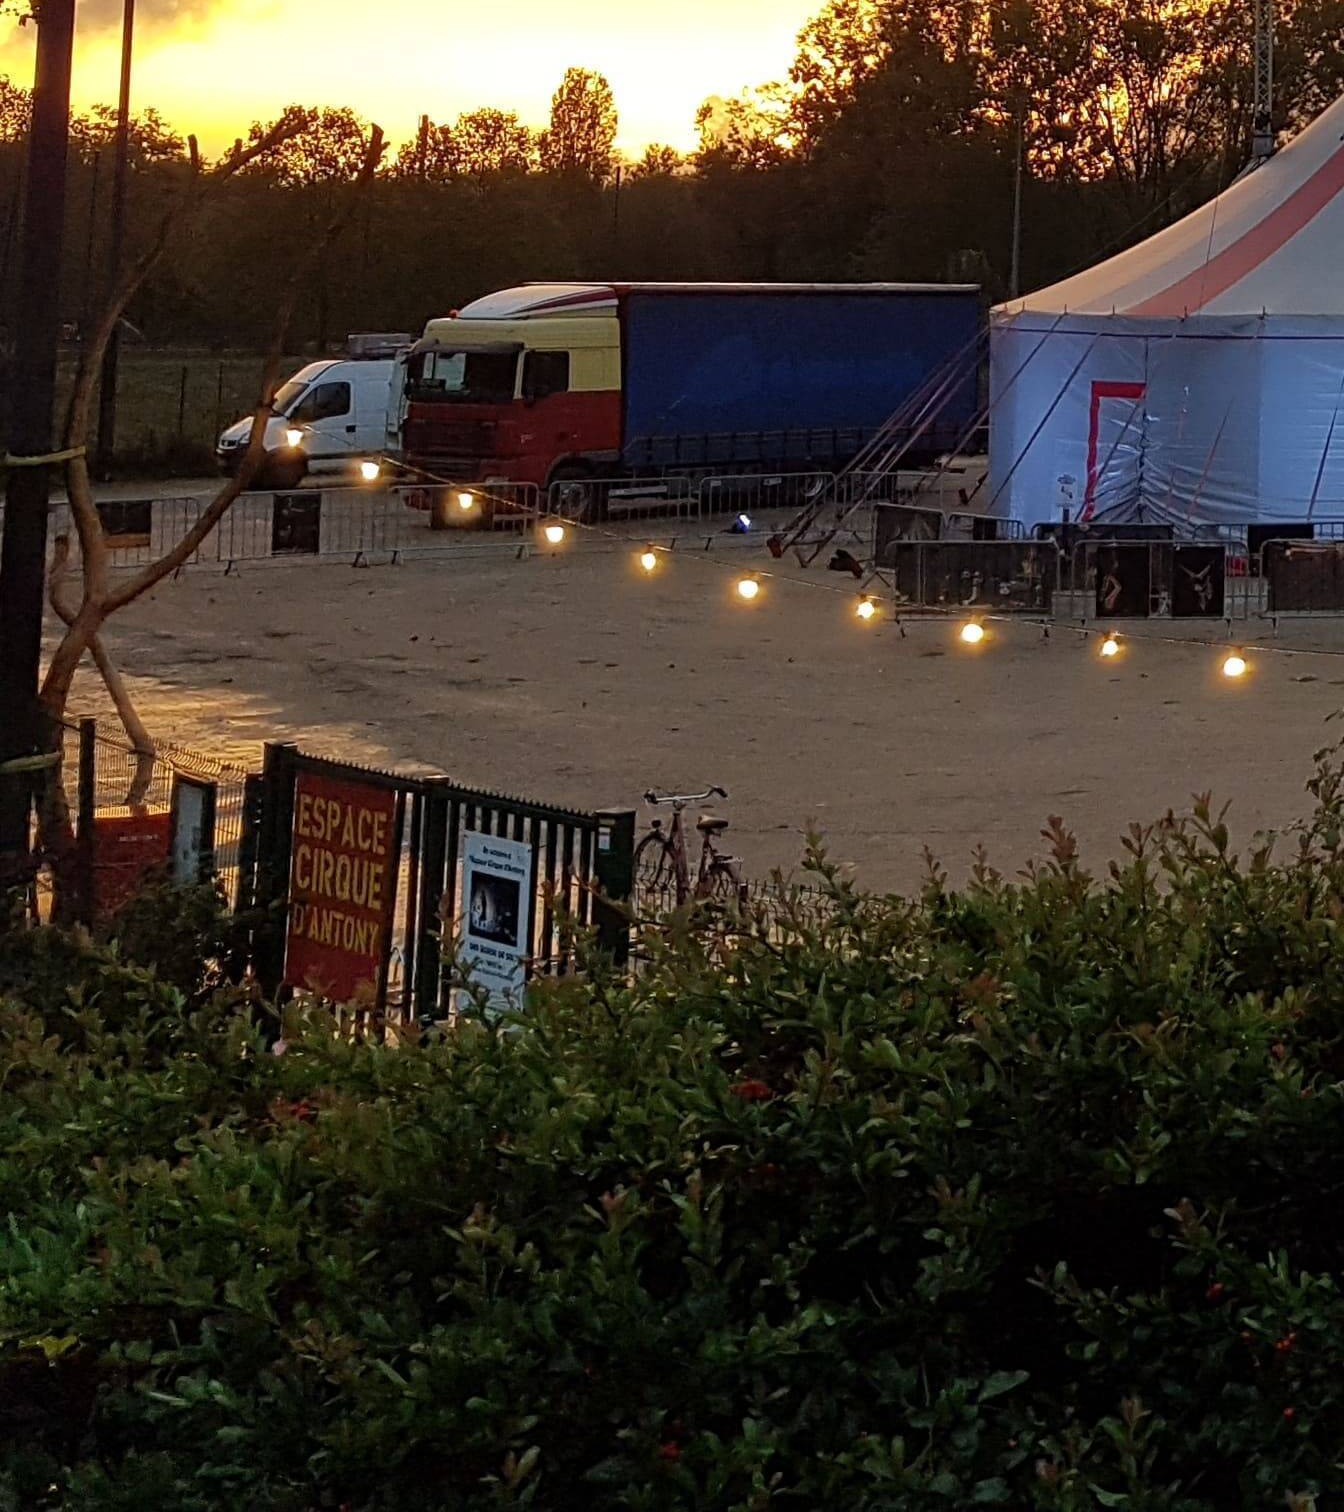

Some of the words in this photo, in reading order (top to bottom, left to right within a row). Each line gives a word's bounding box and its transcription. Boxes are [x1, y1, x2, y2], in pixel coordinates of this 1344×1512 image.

[298, 793, 388, 856] ESPACE
[296, 843, 384, 911] CIRQUE
[293, 902, 380, 958] D'ANTONY
